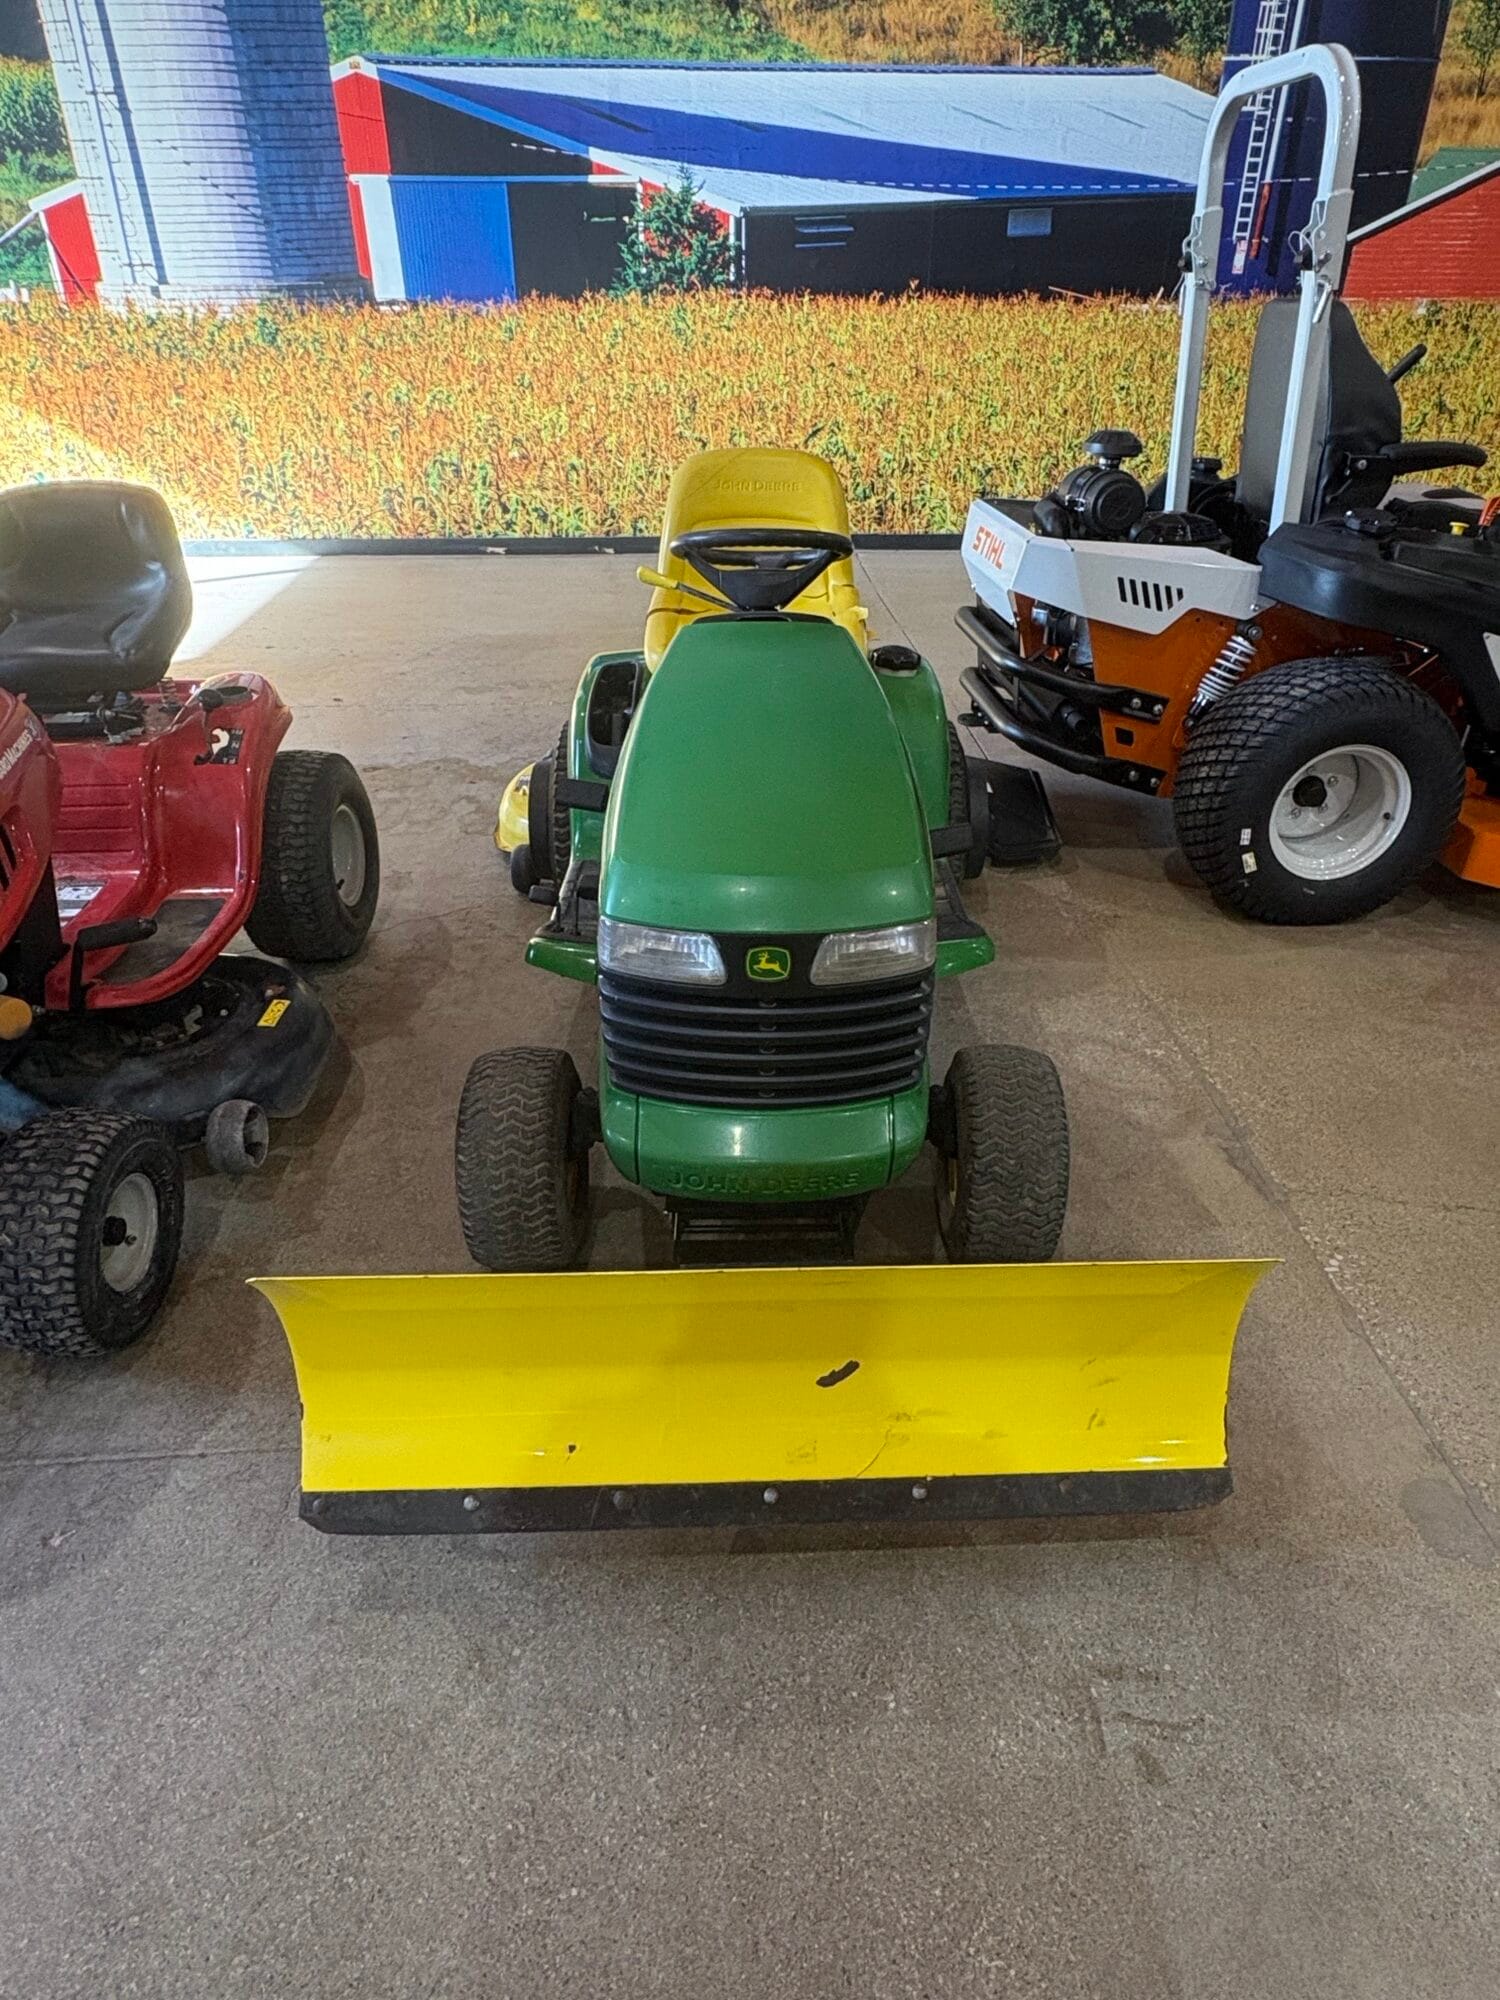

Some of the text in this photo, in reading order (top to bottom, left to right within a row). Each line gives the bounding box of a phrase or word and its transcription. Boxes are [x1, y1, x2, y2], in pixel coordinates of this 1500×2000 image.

[711, 479, 802, 492] JOHN DEERE
[972, 526, 1006, 570] STIHL
[667, 1171, 860, 1195] JOHN DEERE
